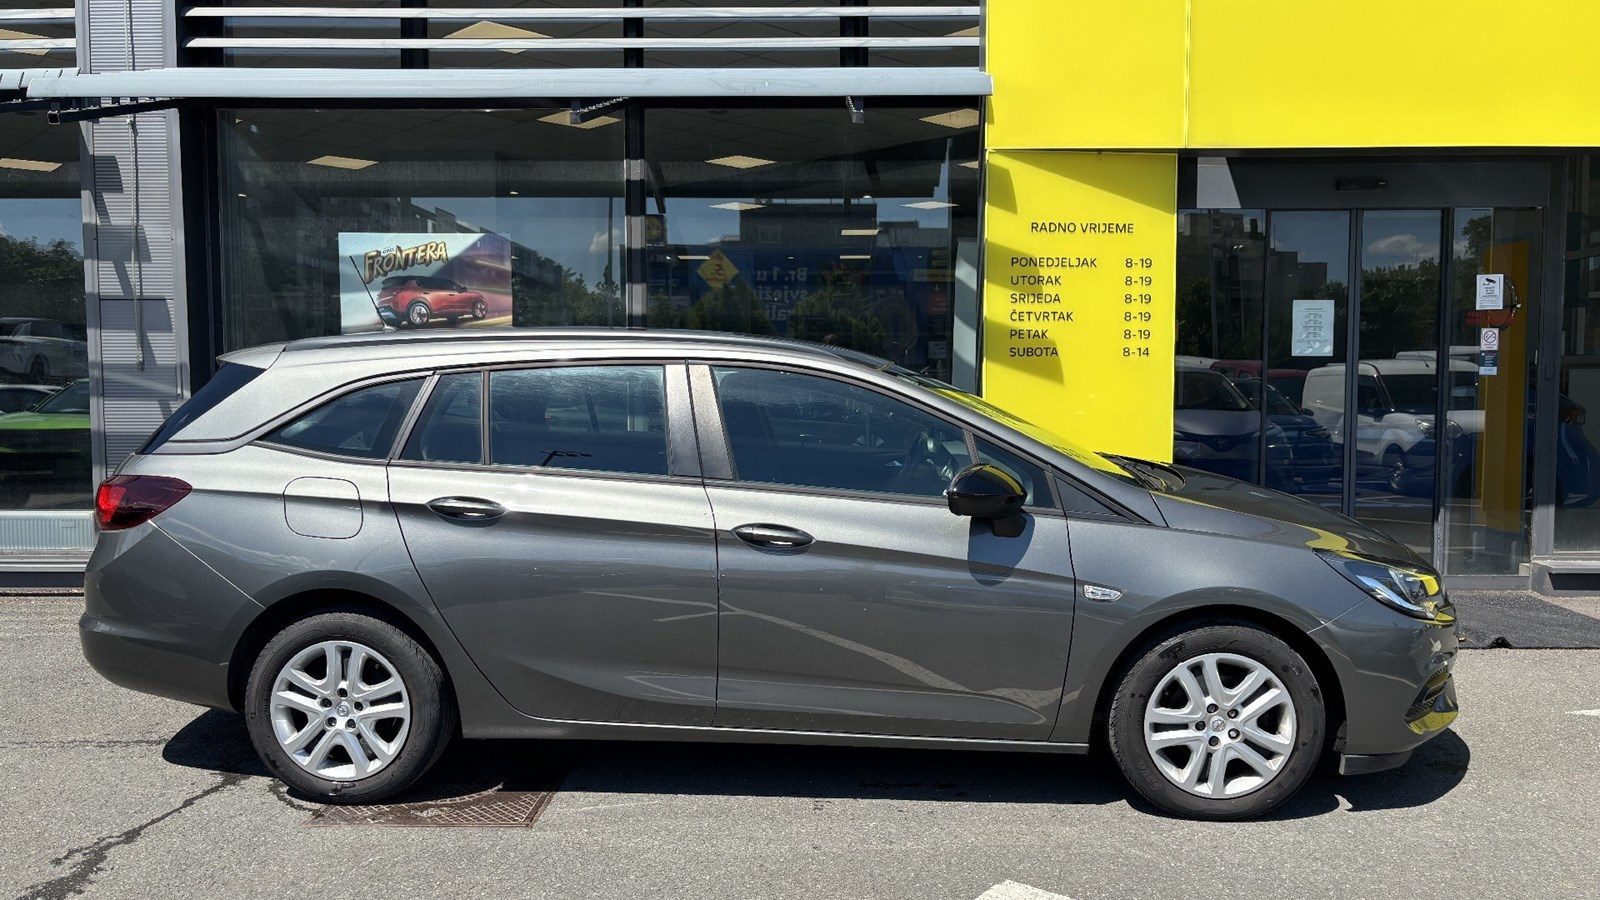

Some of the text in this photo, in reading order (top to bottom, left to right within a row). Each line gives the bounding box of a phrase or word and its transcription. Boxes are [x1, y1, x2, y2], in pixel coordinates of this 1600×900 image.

[1031, 222, 1133, 234] RADNO VRIJEME
[363, 241, 449, 284] FRONTERA
[1011, 257, 1152, 269] PONEDJELJAK 8-19
[1011, 276, 1152, 287] UTORAK 8-19
[1011, 293, 1151, 304] SRIJEDA 8-19
[1010, 309, 1151, 322] ČETVRTAK 8-19
[1010, 329, 1150, 340] PETAK 8-19
[1010, 347, 1150, 357] SUBOTA 8-14
